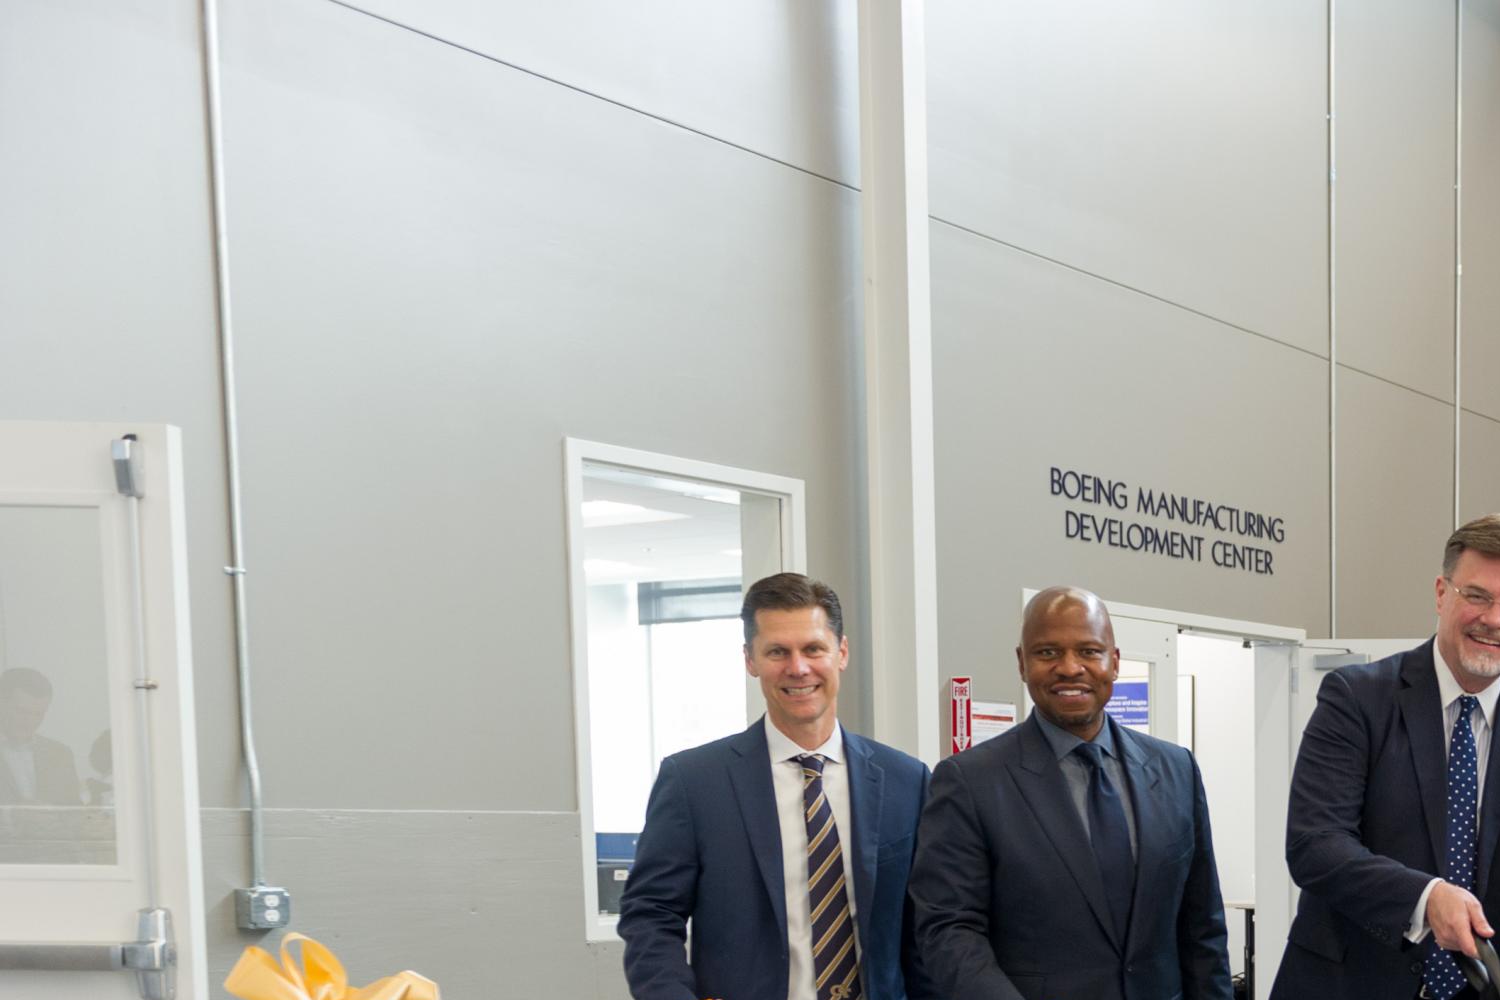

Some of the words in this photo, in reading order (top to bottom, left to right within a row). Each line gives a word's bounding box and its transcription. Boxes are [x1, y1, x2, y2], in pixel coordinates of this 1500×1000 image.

[1050, 467, 1128, 510] BOEING
[1137, 487, 1285, 543] MANUFACTURING
[1065, 510, 1204, 562] DEVELOPMENT
[1211, 540, 1274, 575] CENTER
[954, 686, 968, 696] FIRE
